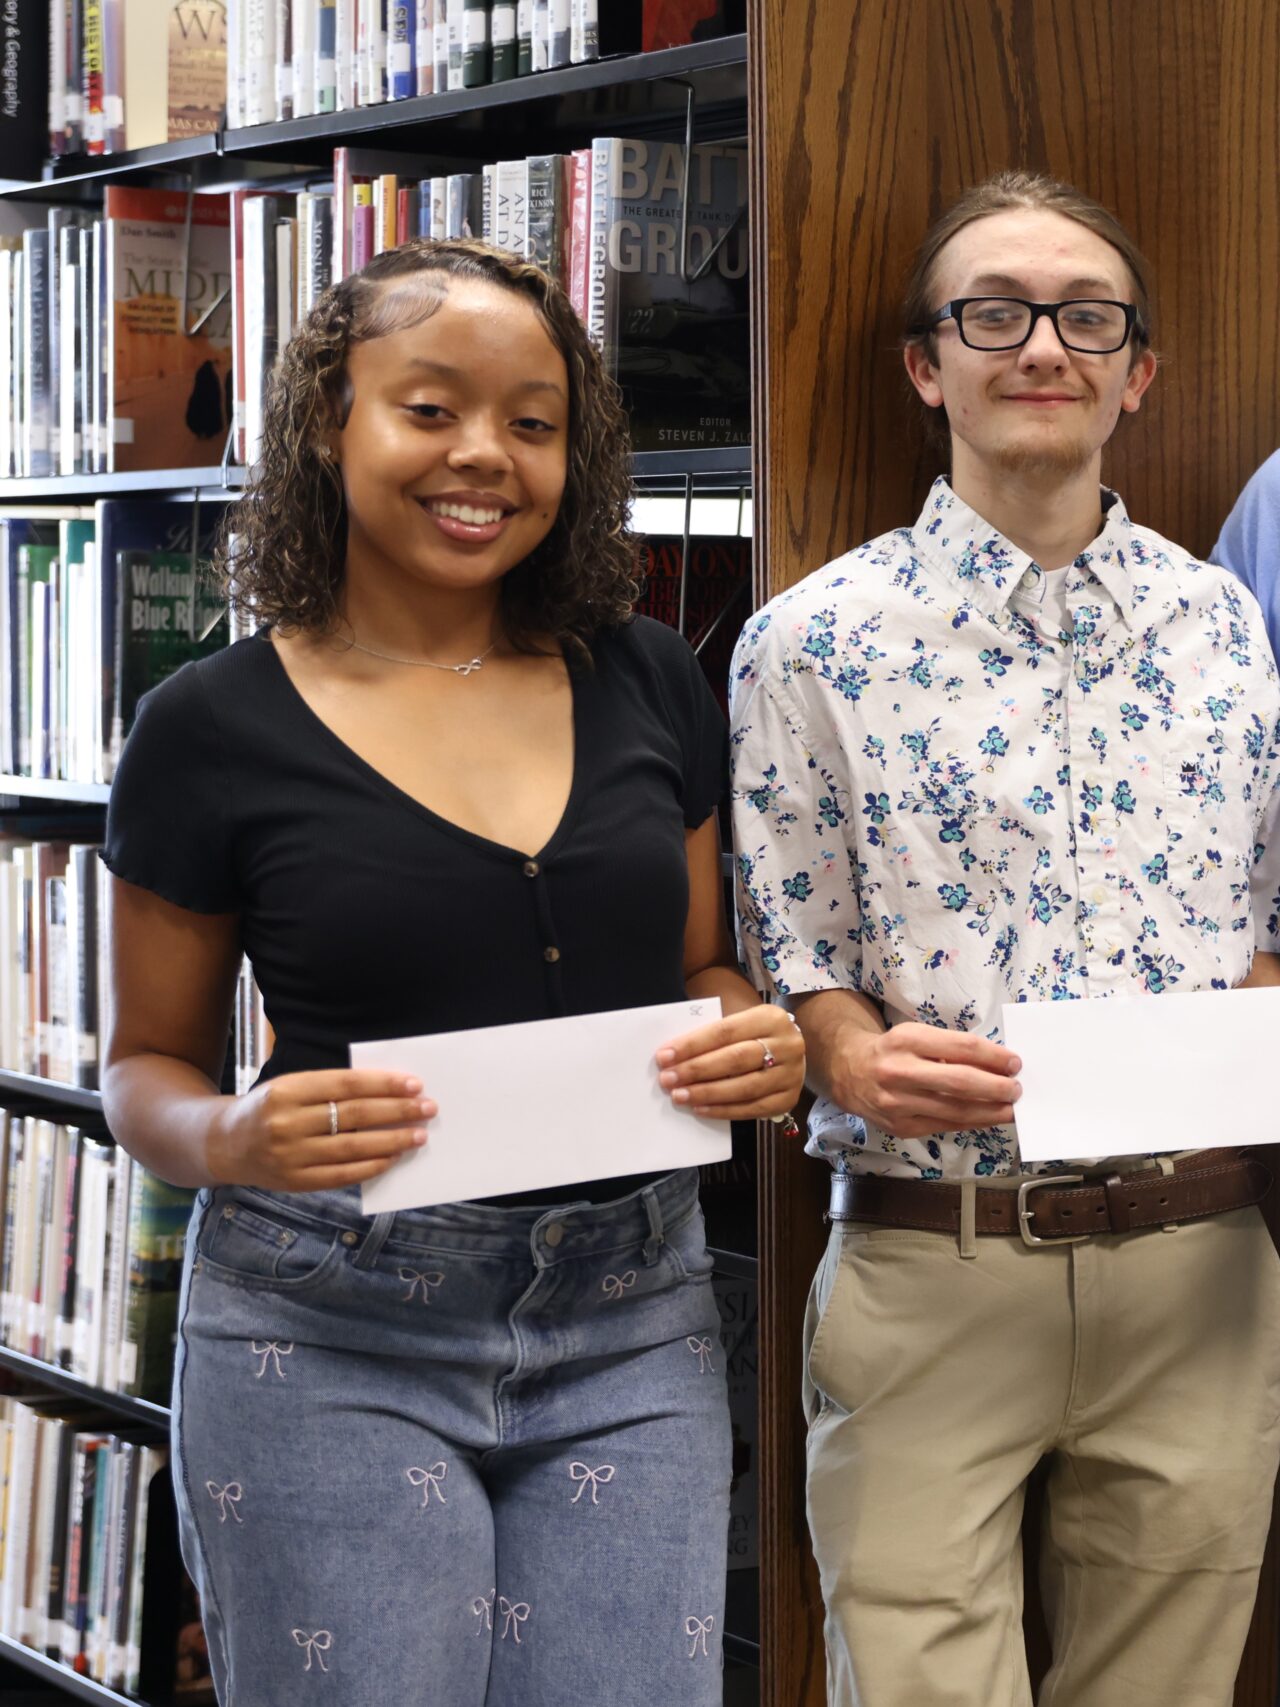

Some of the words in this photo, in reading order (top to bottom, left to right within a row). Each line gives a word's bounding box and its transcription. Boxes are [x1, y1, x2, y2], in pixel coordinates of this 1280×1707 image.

[0, 0, 20, 25] ory
[4, 25, 21, 38] &
[1, 40, 22, 118] Geography
[482, 174, 492, 237] STEPHEN
[498, 194, 510, 221] AT
[514, 192, 525, 225] AN
[623, 205, 643, 217] THE
[645, 206, 694, 220] GREATET
[698, 210, 723, 222] TANK
[120, 226, 144, 237] Dan
[146, 228, 177, 240] Smith
[608, 219, 749, 280] GROU
[658, 429, 705, 441] STEVEN
[709, 431, 720, 442] J.
[699, 417, 732, 427] EDITOR
[131, 564, 196, 597] Walkin
[131, 599, 171, 631] Blue
